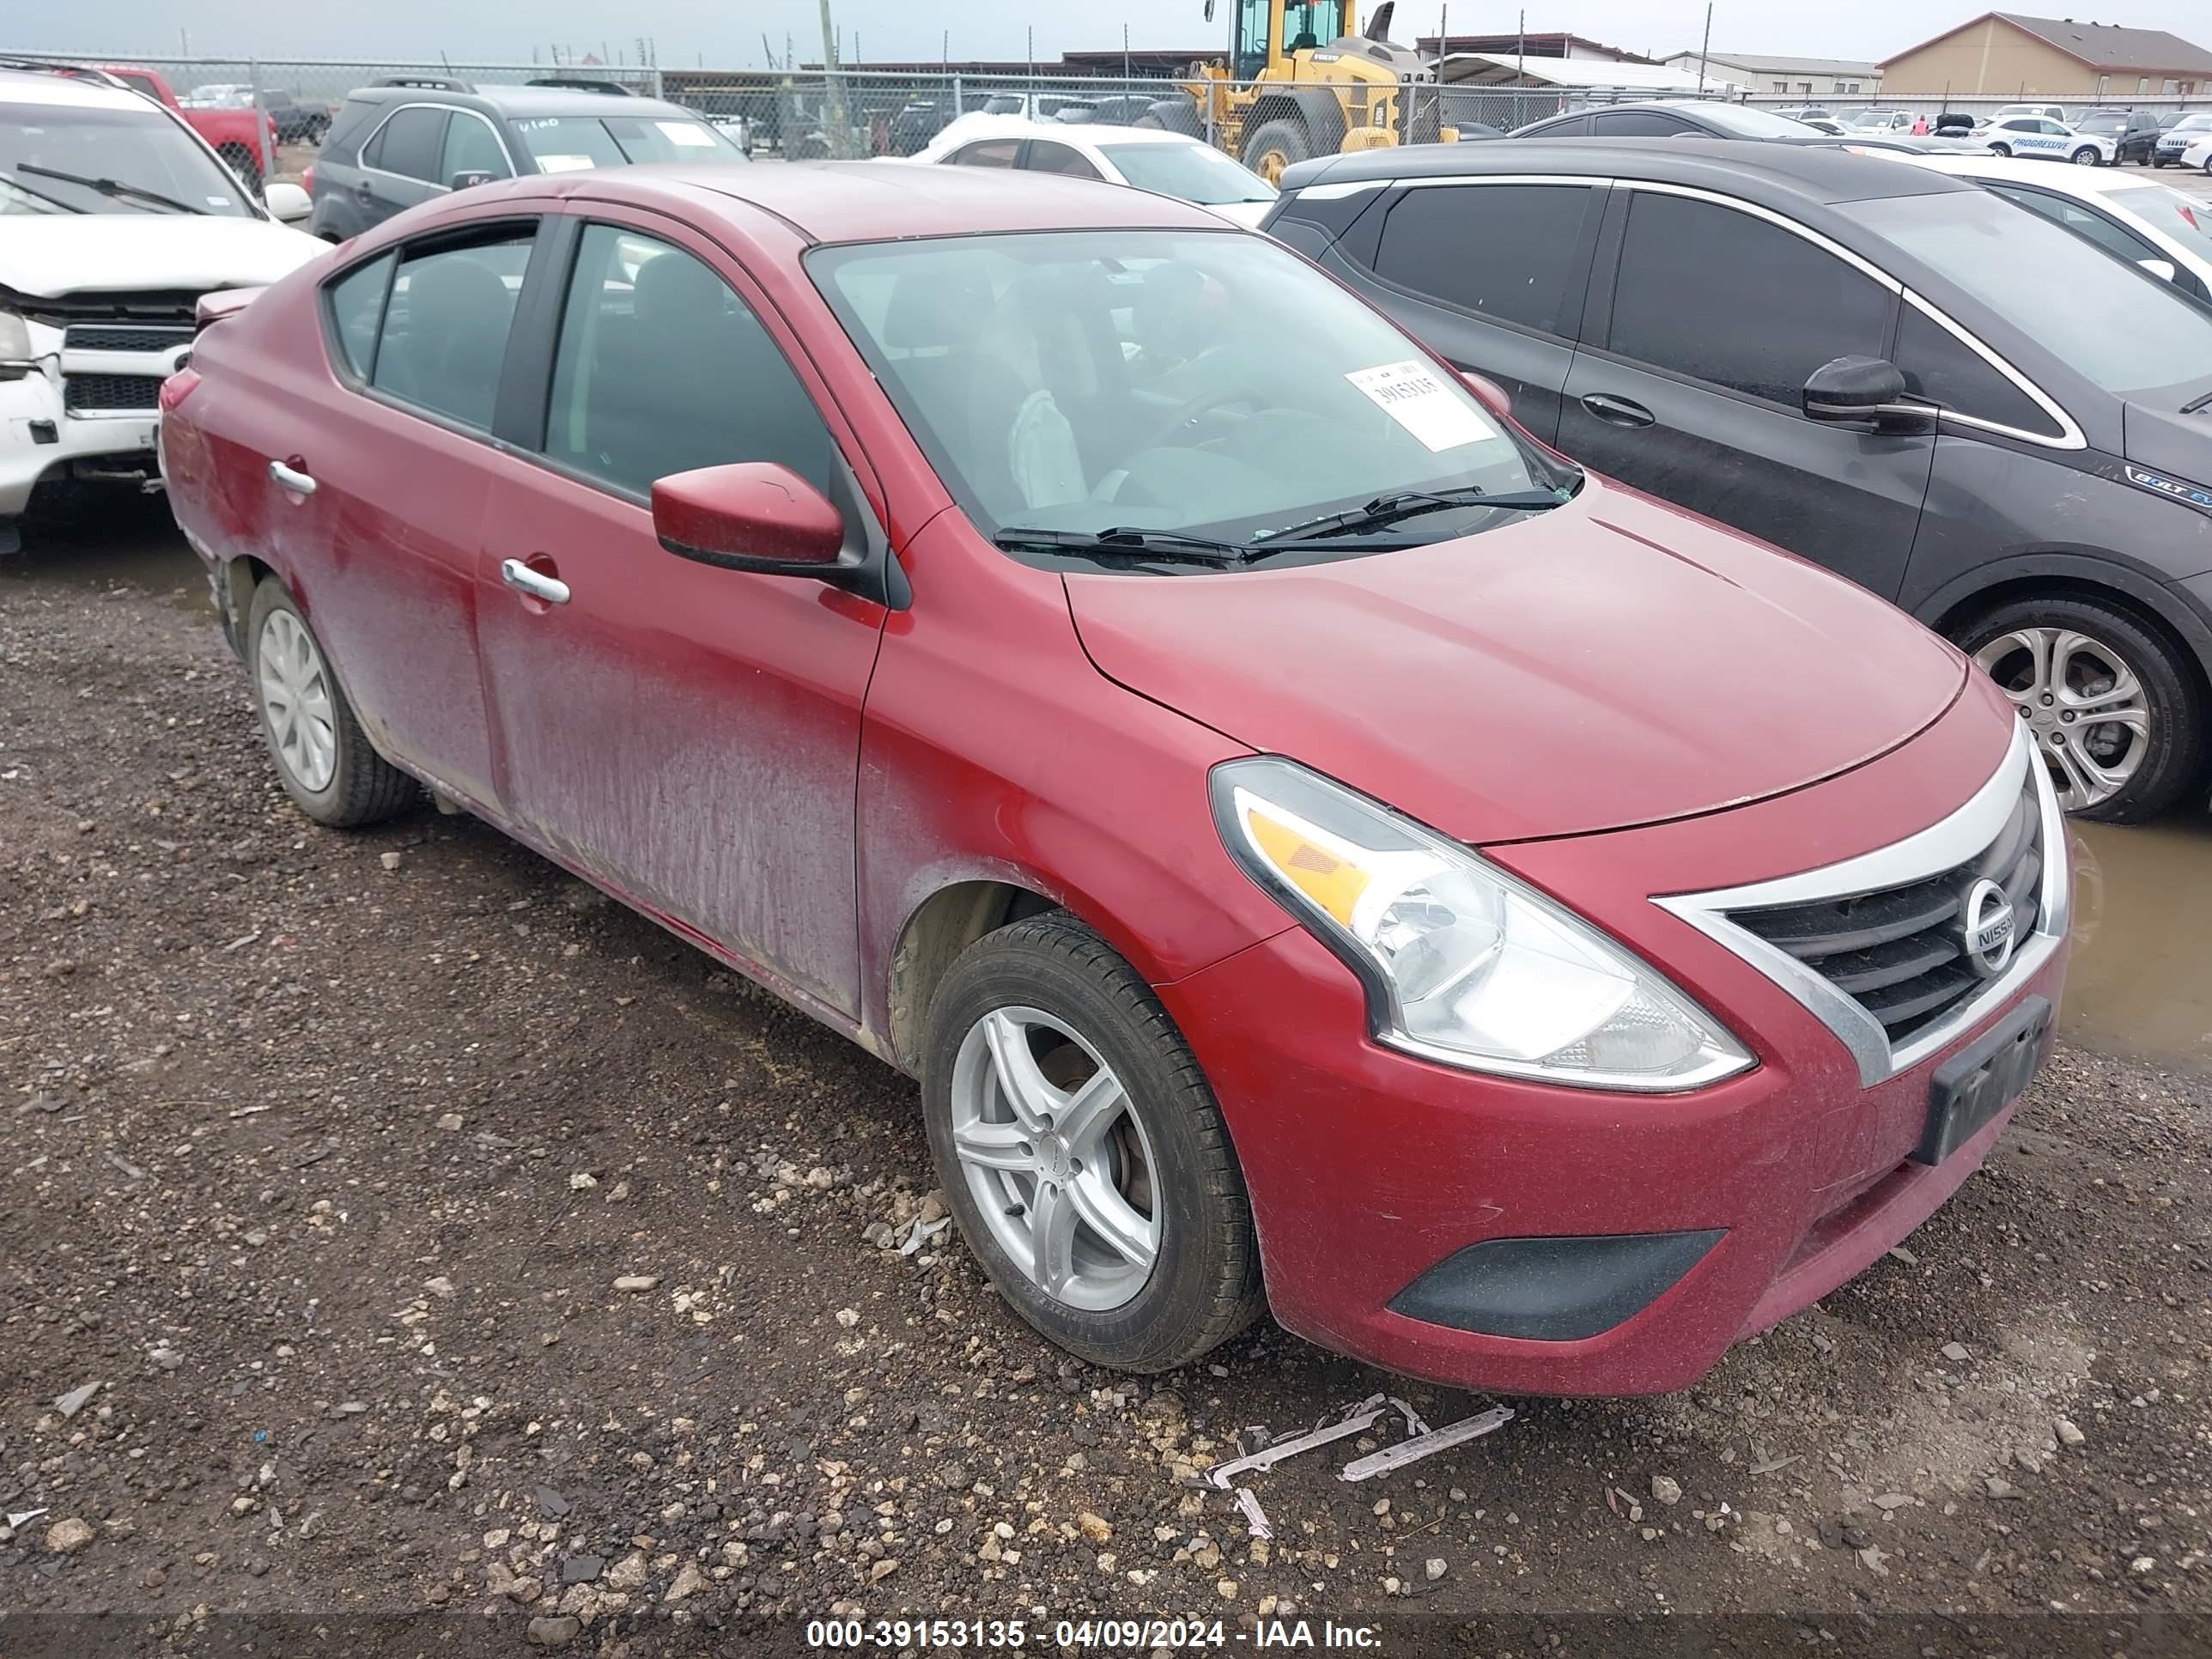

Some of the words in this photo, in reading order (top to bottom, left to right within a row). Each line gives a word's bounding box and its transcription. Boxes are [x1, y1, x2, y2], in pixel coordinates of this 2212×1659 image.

[2012, 138, 2070, 150] PROGRESSIVE
[1375, 377, 1438, 404] 39153135
[2135, 473, 2187, 493] BOLT
